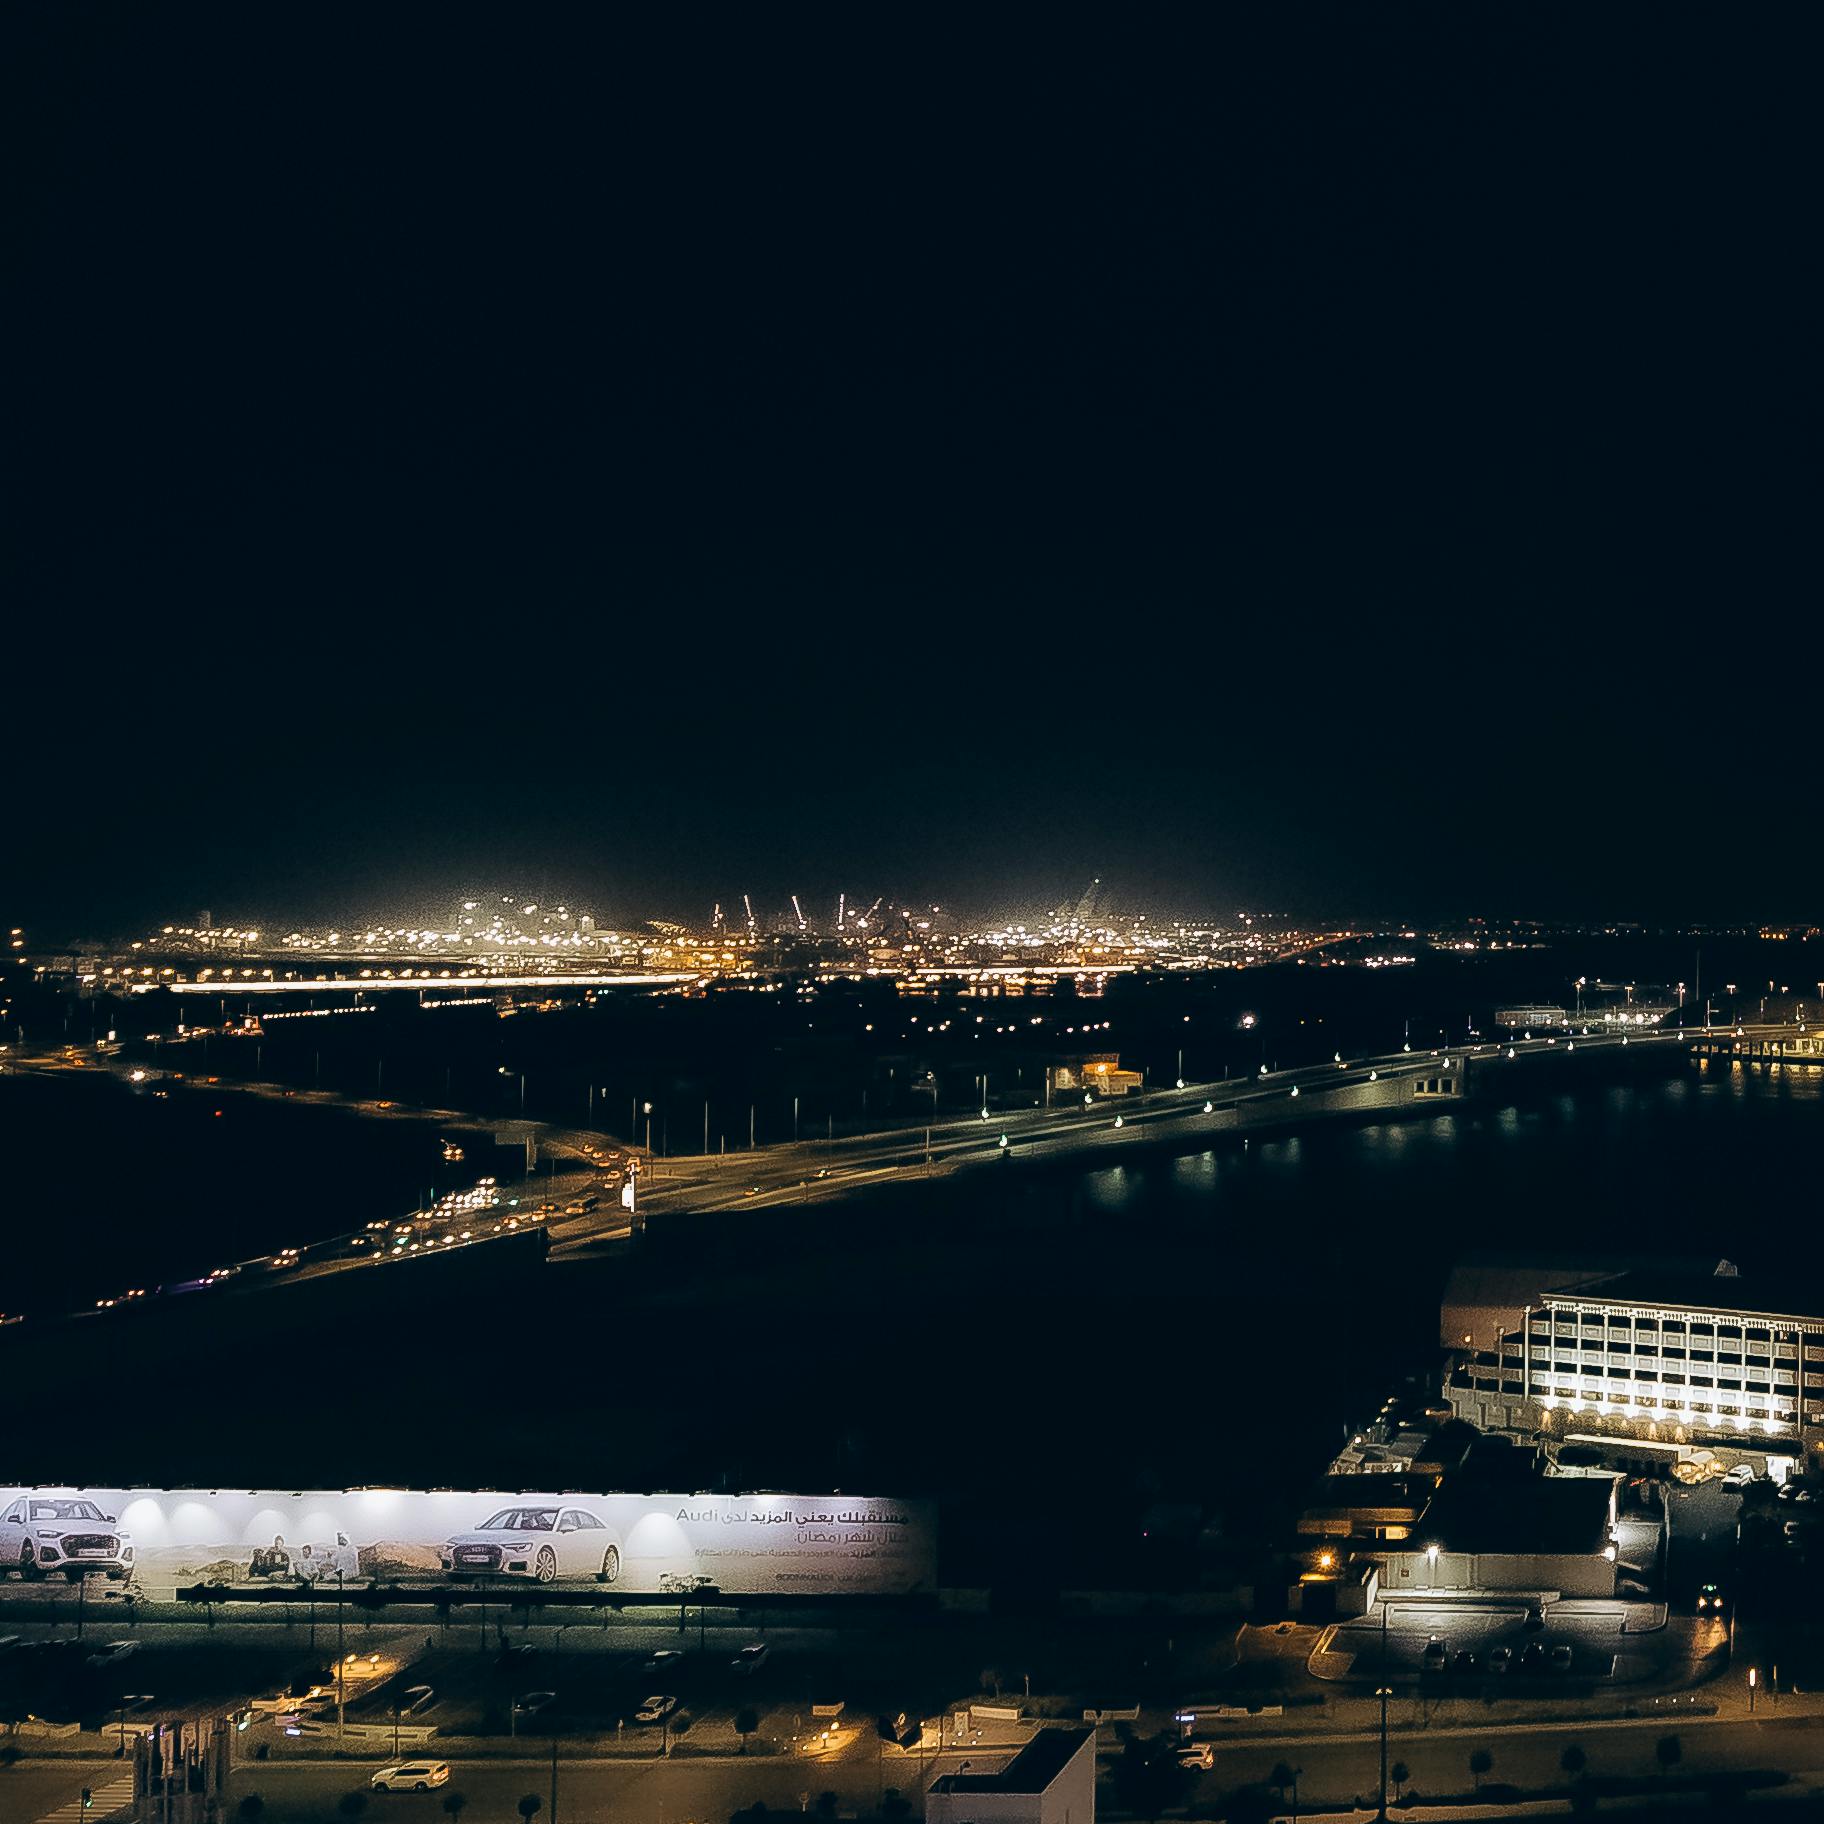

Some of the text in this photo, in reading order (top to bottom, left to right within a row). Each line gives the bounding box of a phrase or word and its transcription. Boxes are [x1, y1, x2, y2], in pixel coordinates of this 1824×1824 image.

[676, 1508, 718, 1521] Audi
[750, 1511, 792, 1525] المزيد
[795, 1511, 834, 1529] يعني
[838, 1510, 909, 1526] مستقبلك
[844, 1530, 875, 1545] شهر
